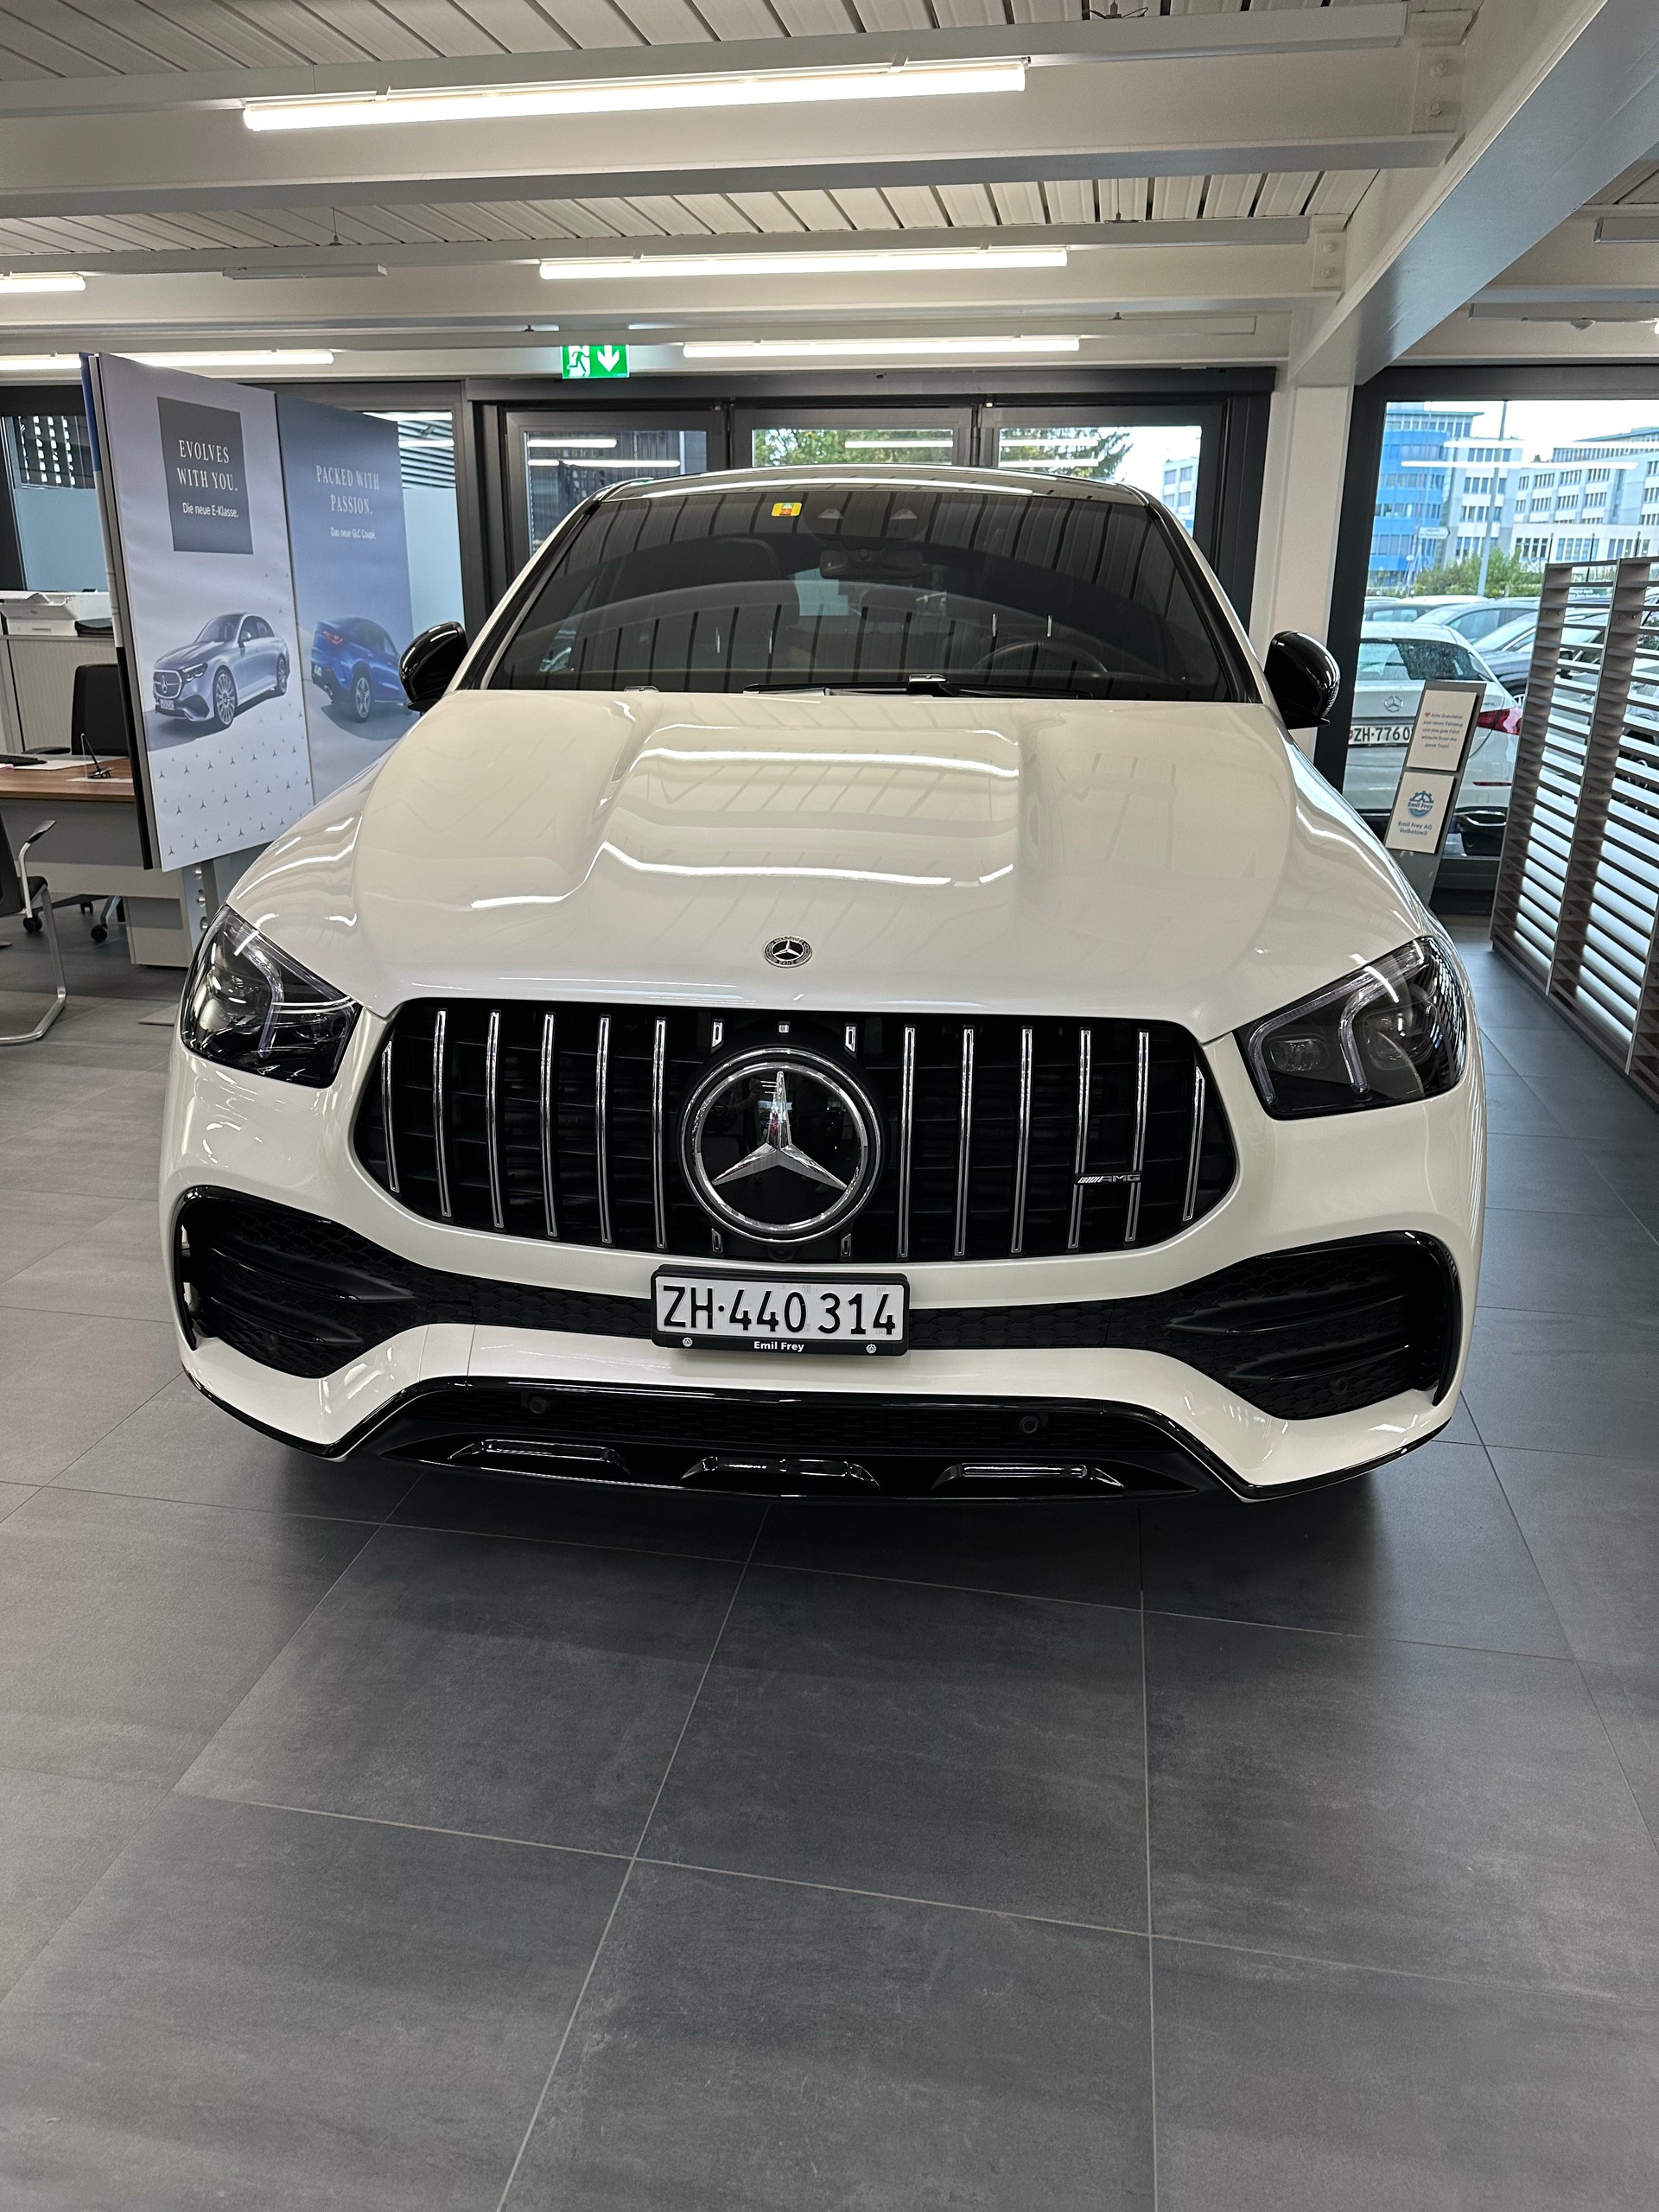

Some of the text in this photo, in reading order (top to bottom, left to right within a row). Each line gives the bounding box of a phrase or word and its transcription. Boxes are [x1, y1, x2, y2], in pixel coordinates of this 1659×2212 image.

[179, 439, 230, 464] EVOLVES
[176, 467, 238, 492] WITH YOU.
[316, 465, 380, 490] PACKED WITH
[182, 502, 238, 518] Die neue E-Klasse.
[330, 493, 373, 515] PASSION.
[753, 1340, 805, 1353] Emil Frey
